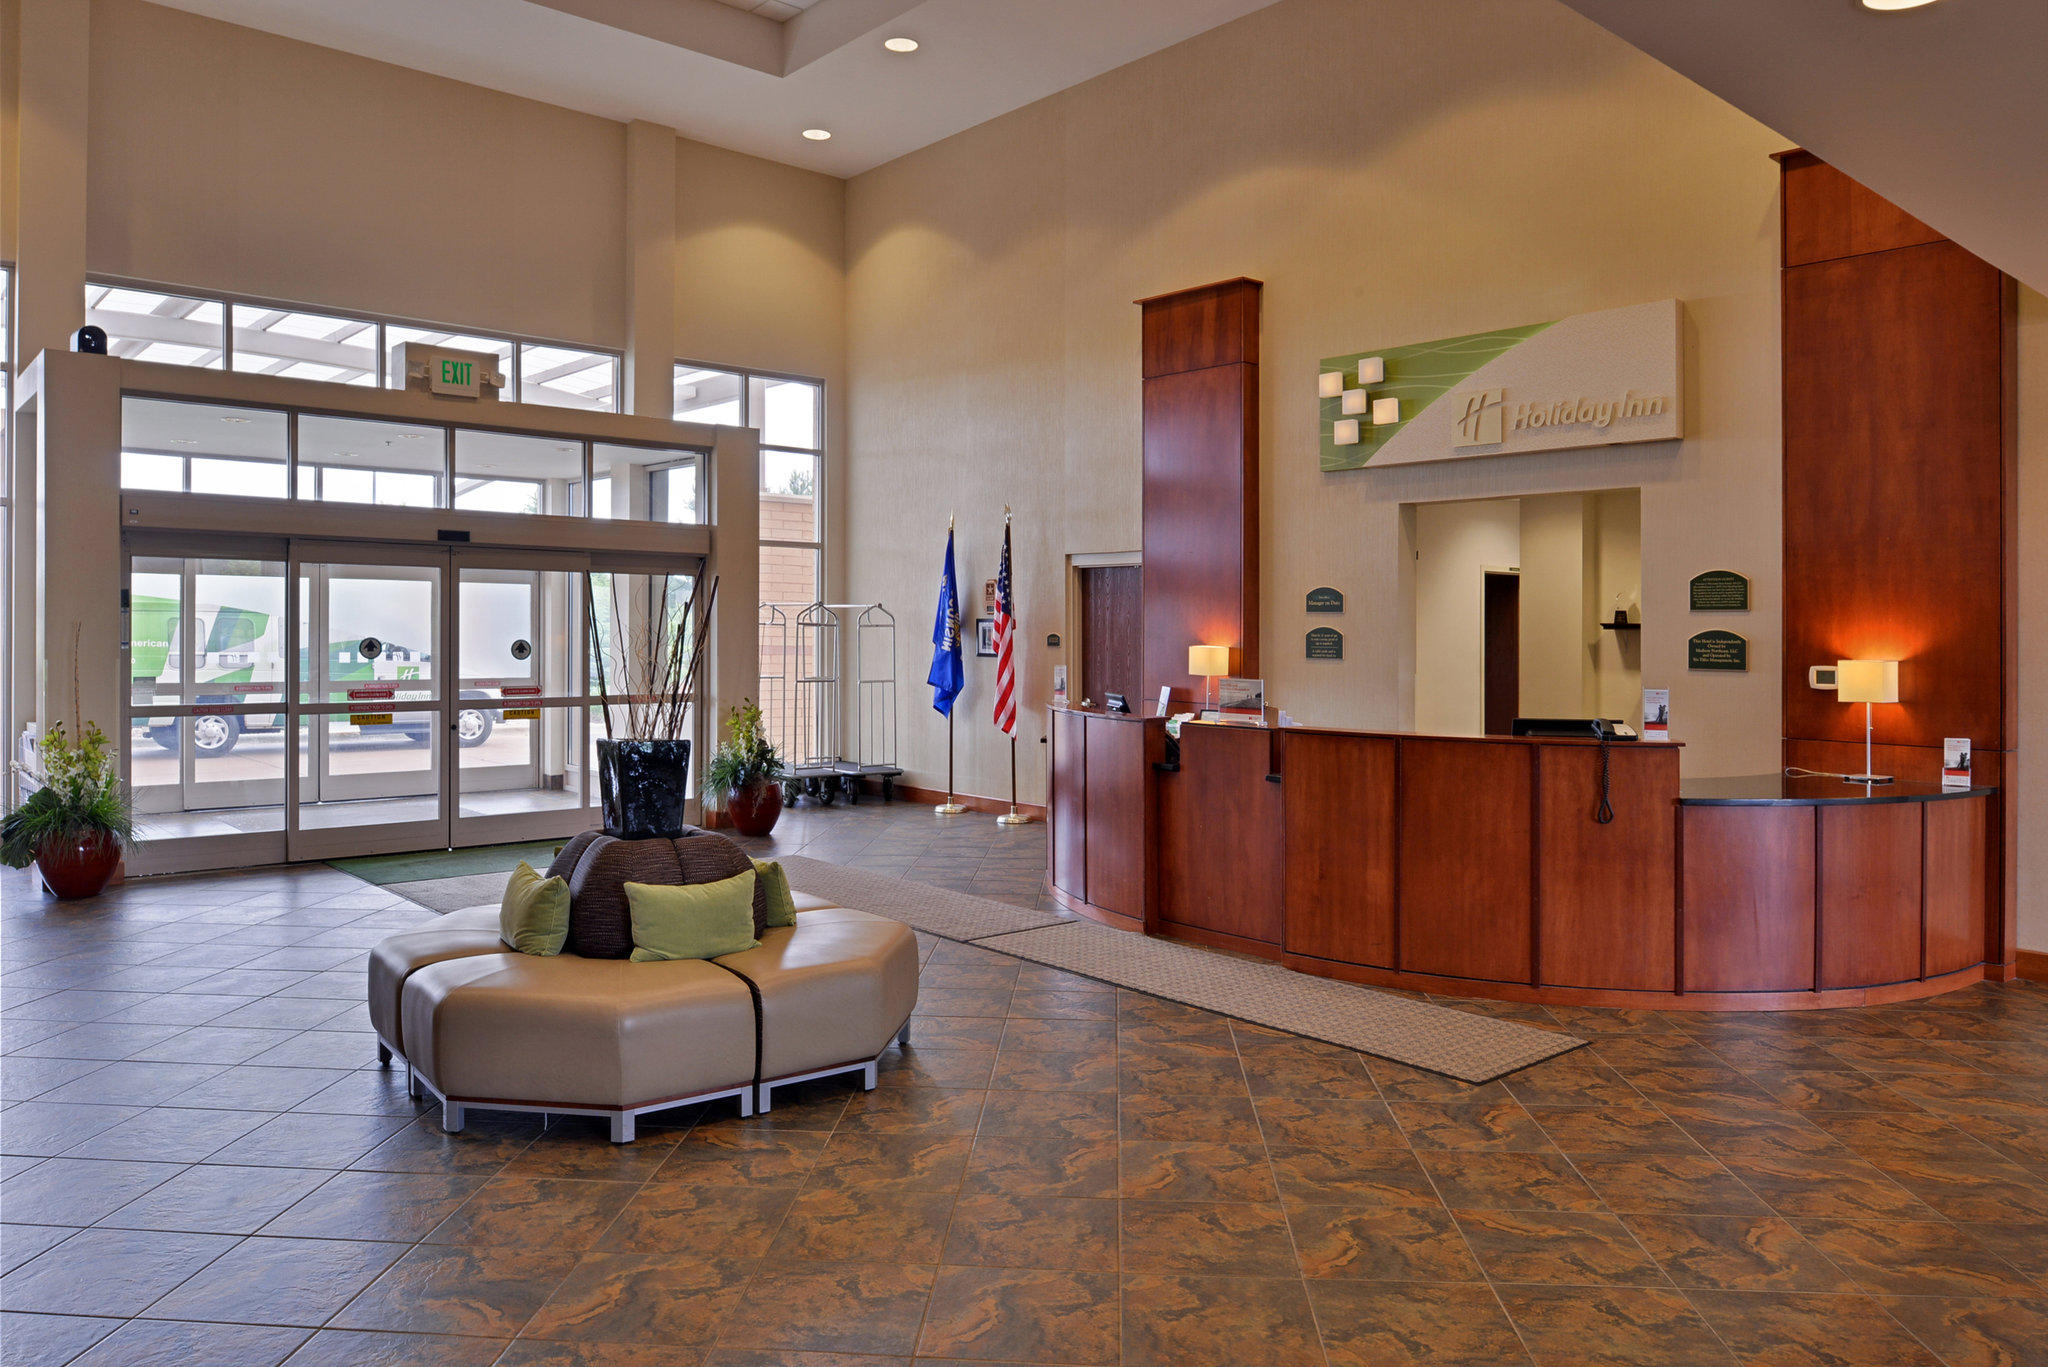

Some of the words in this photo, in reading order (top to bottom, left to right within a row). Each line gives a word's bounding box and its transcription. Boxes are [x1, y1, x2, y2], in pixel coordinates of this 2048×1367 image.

[442, 360, 472, 386] EXIT
[1513, 397, 1615, 430] Holiday
[1619, 390, 1665, 418] Inn
